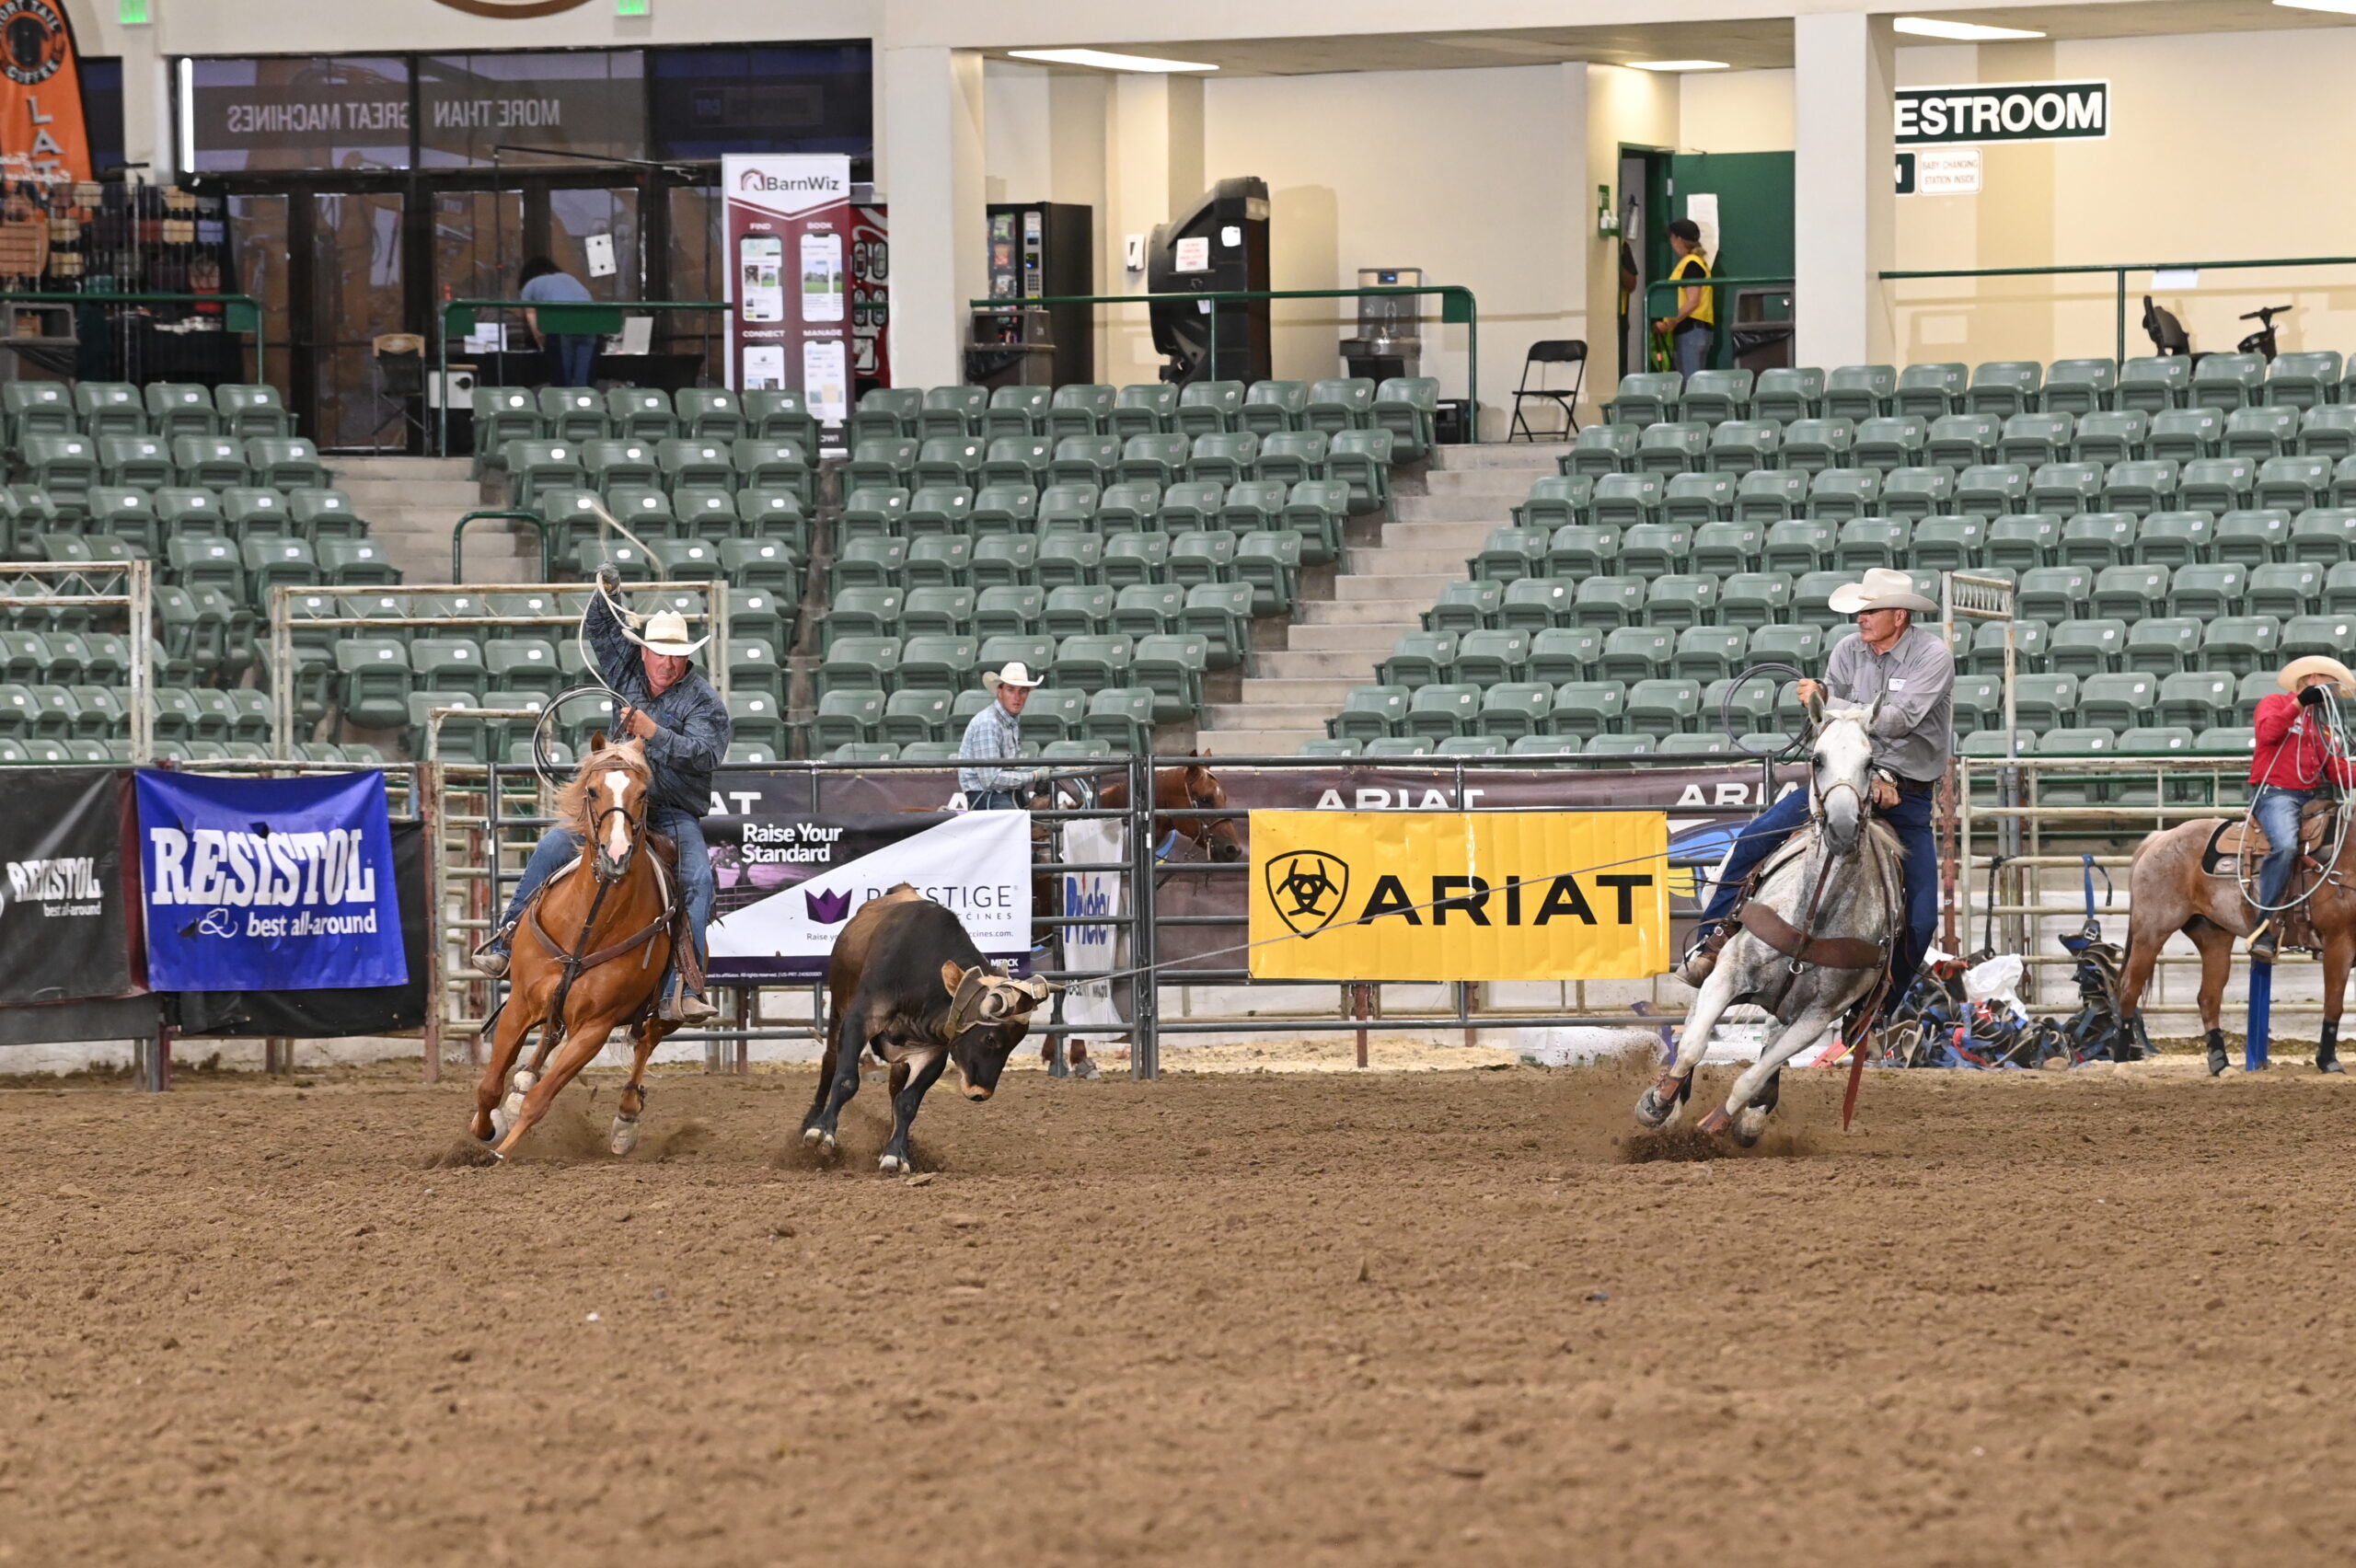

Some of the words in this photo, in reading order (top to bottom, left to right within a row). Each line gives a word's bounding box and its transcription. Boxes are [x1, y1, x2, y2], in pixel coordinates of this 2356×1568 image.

[6, 62, 61, 84] COFFEE
[1894, 91, 2103, 136] ESTROOM
[27, 96, 64, 190] LAT
[1943, 159, 1978, 169] CHANGING
[766, 176, 839, 190] BarnWiz
[1924, 175, 1951, 185] STATION
[1954, 174, 1975, 184] INSIDE
[806, 222, 833, 230] BOOK
[742, 329, 784, 339] CONNECT
[803, 329, 843, 337] MANAGE
[1315, 789, 1484, 810] ARIAT
[1676, 781, 1799, 806] ARIA
[743, 823, 795, 842] Raise
[797, 823, 844, 842] Your
[741, 843, 831, 862] Standard
[150, 827, 375, 907] RESISTOL
[867, 885, 1012, 908] PSTIGE
[1357, 873, 1654, 927] ARIAT
[42, 903, 61, 917] best
[246, 911, 287, 937] best
[290, 908, 377, 936] all-around
[806, 932, 828, 940] Raise
